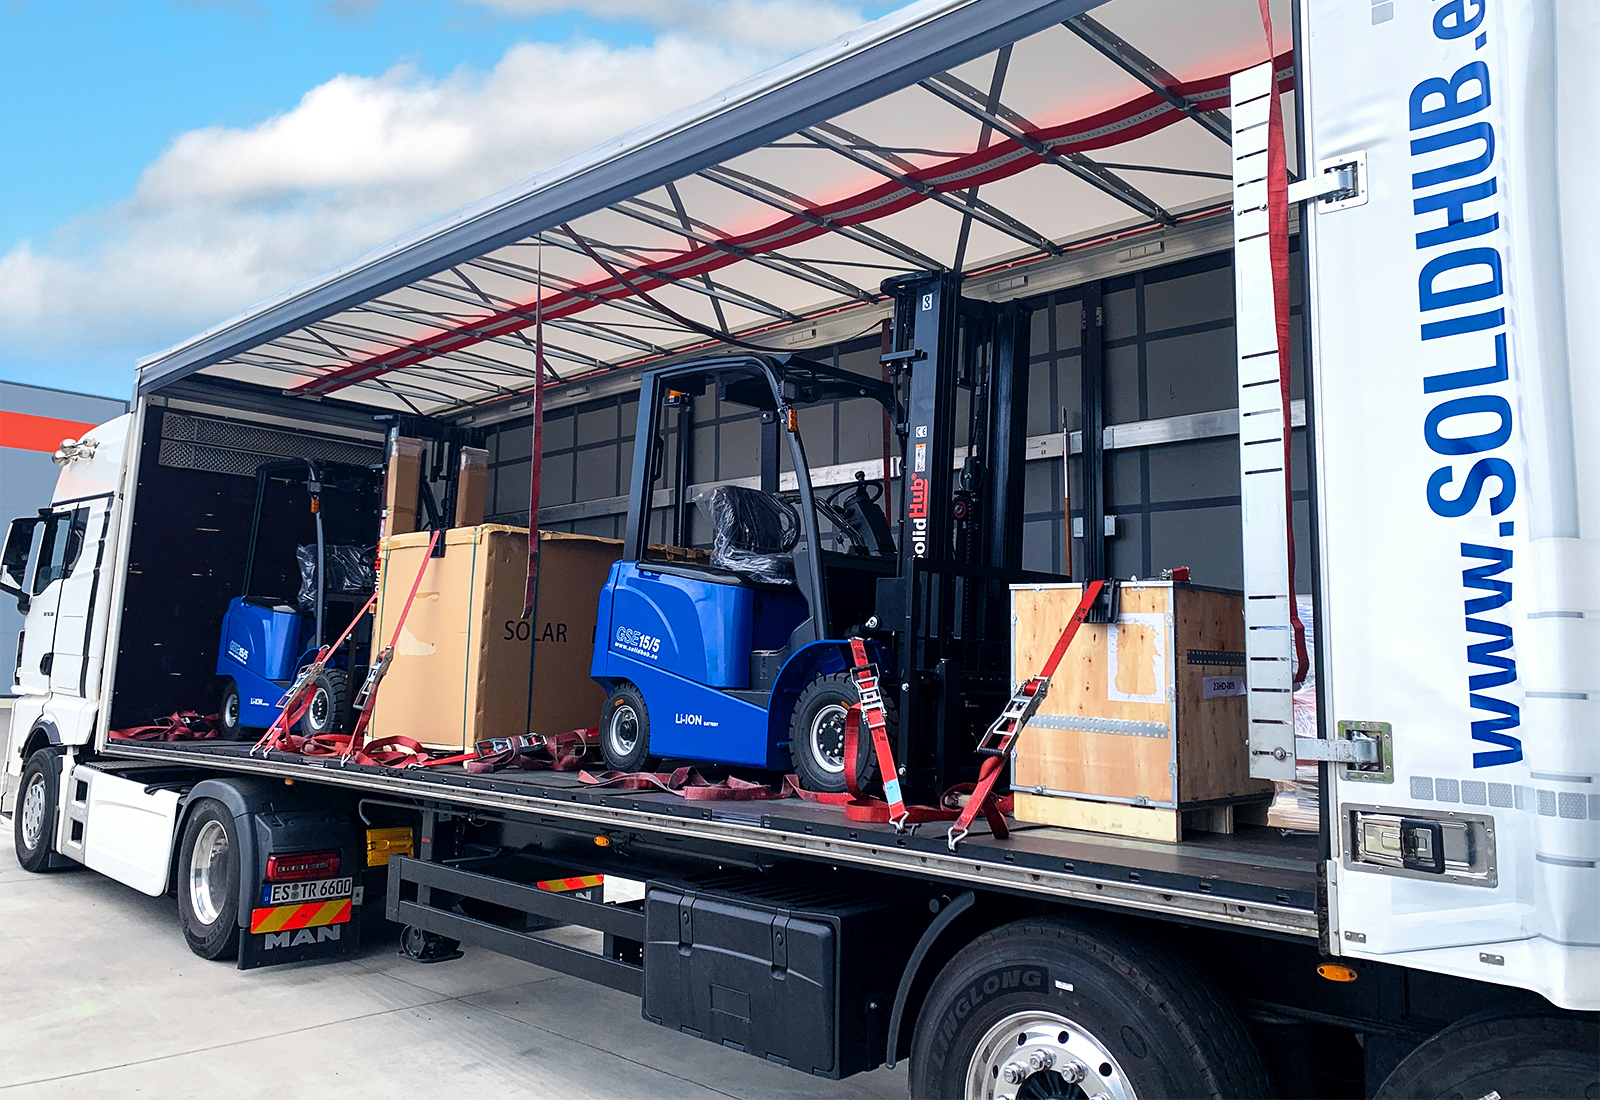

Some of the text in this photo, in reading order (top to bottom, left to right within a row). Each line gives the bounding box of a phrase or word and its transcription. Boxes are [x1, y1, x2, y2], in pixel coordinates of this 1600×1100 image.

[1408, 0, 1523, 769] www.SOLIDHUB.e
[909, 478, 928, 558] olidHub
[272, 880, 352, 902] ES TR 6600
[265, 925, 340, 950] MAN
[933, 969, 1042, 1070] LINGLONG
